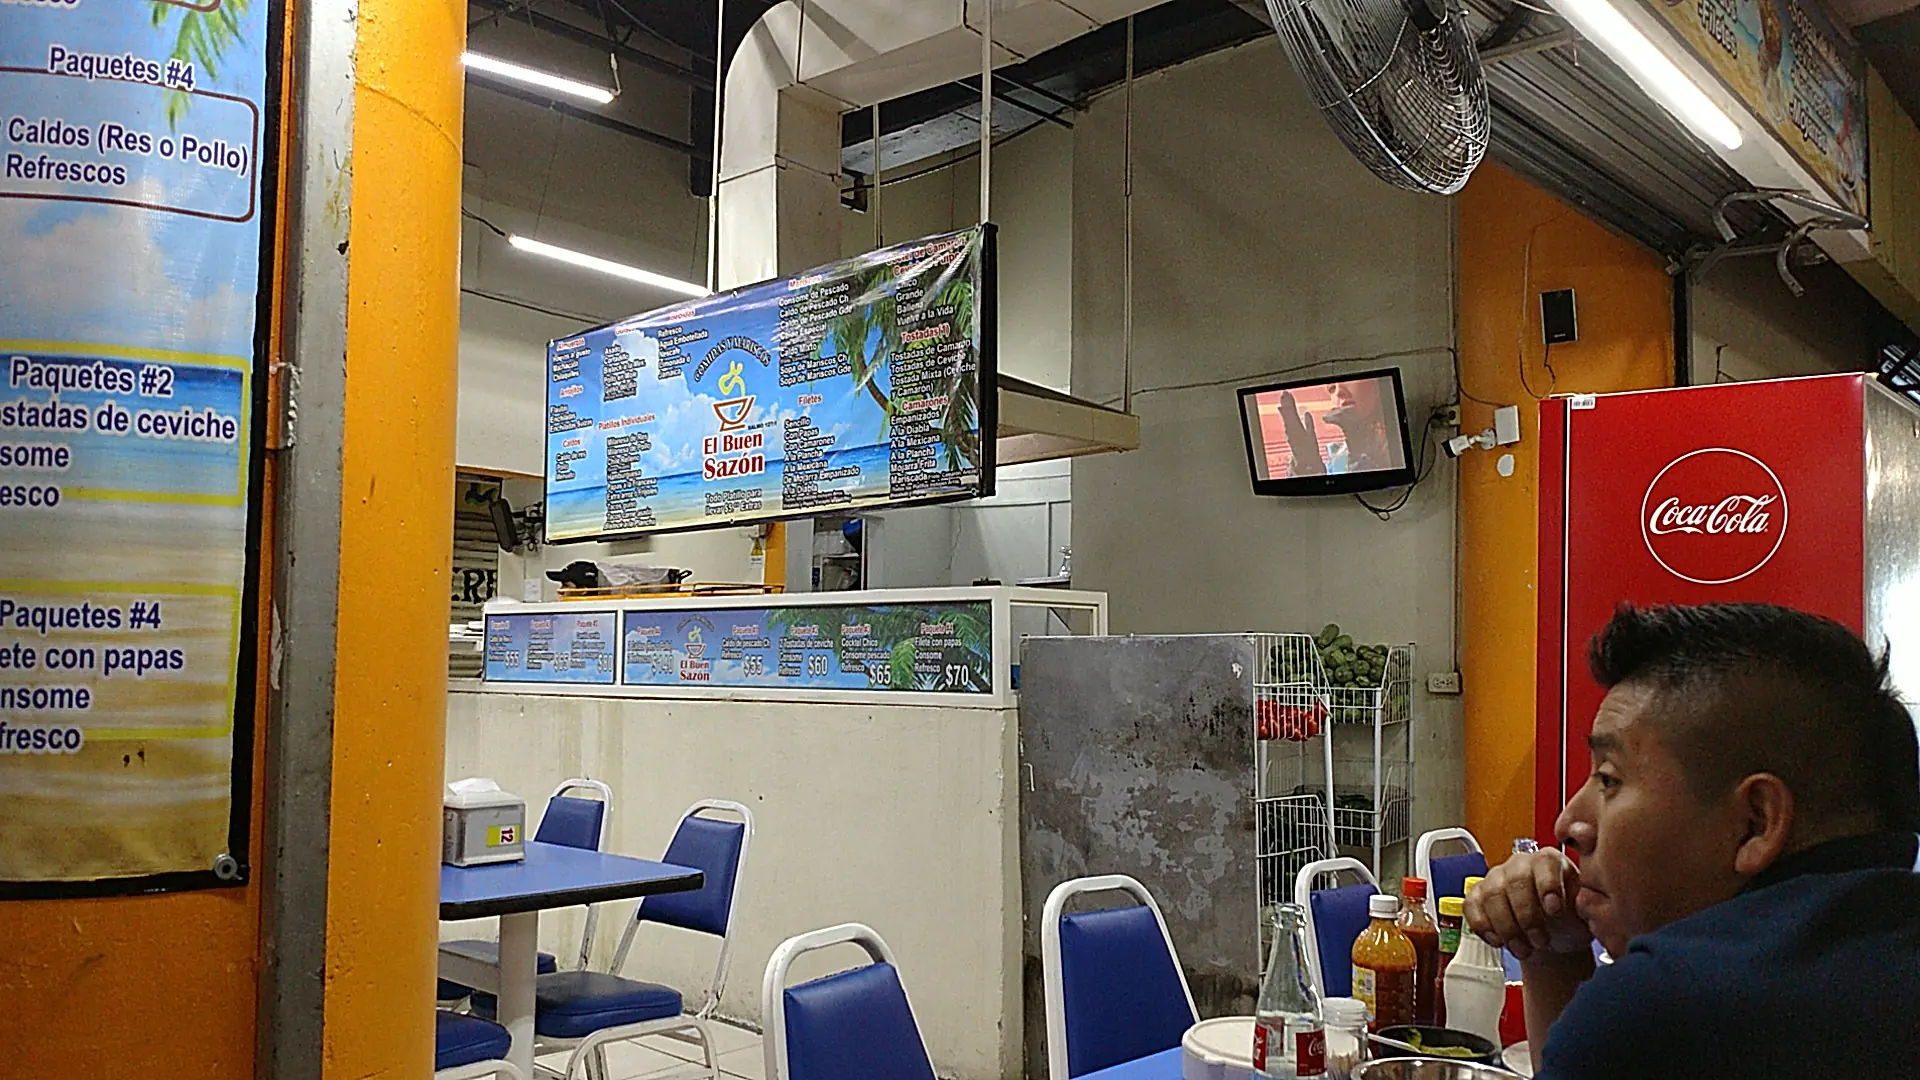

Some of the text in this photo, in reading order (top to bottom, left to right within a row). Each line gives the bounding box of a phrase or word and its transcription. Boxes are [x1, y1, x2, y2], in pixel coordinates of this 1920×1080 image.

[49, 46, 195, 88] Paquetes #4
[8, 117, 249, 176] Caldos (Res o Pollo)
[6, 153, 127, 185] Refrescos
[811, 290, 819, 299] de
[820, 282, 850, 298] Pescado
[895, 288, 925, 302] Grande
[799, 304, 808, 314] de
[809, 297, 838, 312] Pescado
[838, 294, 849, 304] Ch
[936, 304, 954, 318] Vida
[694, 340, 727, 382] COMIDAS
[733, 335, 771, 367] MARISCOS
[890, 345, 935, 363] Tostadas de
[779, 364, 796, 375] Sopa
[797, 362, 806, 371] de
[806, 356, 837, 369] Mariscos
[837, 352, 849, 363] Ch
[890, 351, 967, 375] Tostadas de Ceviche
[12, 358, 173, 396] Paquetes #2
[779, 362, 852, 387] Sopa de Mariscos Gde
[890, 373, 920, 387] Tostada
[921, 368, 942, 381] Mixta
[798, 393, 822, 406] Filetes
[901, 395, 950, 411] Camarones
[0, 401, 236, 439] stadas de ceviche
[784, 416, 812, 429] Sencillo
[890, 410, 941, 427] Empanizados
[784, 428, 819, 441] Con Papas
[890, 423, 931, 438] A la Diabla
[704, 432, 763, 455] El Buen
[784, 436, 836, 452] Con Camarones
[890, 434, 941, 450] A la Mexicana
[783, 453, 790, 463] A
[797, 448, 824, 460] Plancha
[890, 447, 936, 461] A la Plancha
[703, 452, 764, 480] Sazón
[783, 464, 790, 474] A
[797, 460, 829, 471] Mexicana
[819, 466, 861, 481] Empanizado
[890, 462, 919, 474] Mojarra
[890, 472, 928, 485] Mariscada
[705, 488, 763, 504] Todo Platillo para
[783, 486, 790, 496] A
[1649, 494, 1779, 535] Coca-Cola
[0, 599, 161, 634] Paquetes #4
[931, 638, 943, 647] con
[943, 638, 962, 649] papas
[45, 647, 94, 669] con
[104, 648, 184, 676] papas
[807, 653, 829, 678] $60
[869, 663, 892, 686] $65
[945, 663, 969, 688] $70
[501, 827, 514, 844] 12
